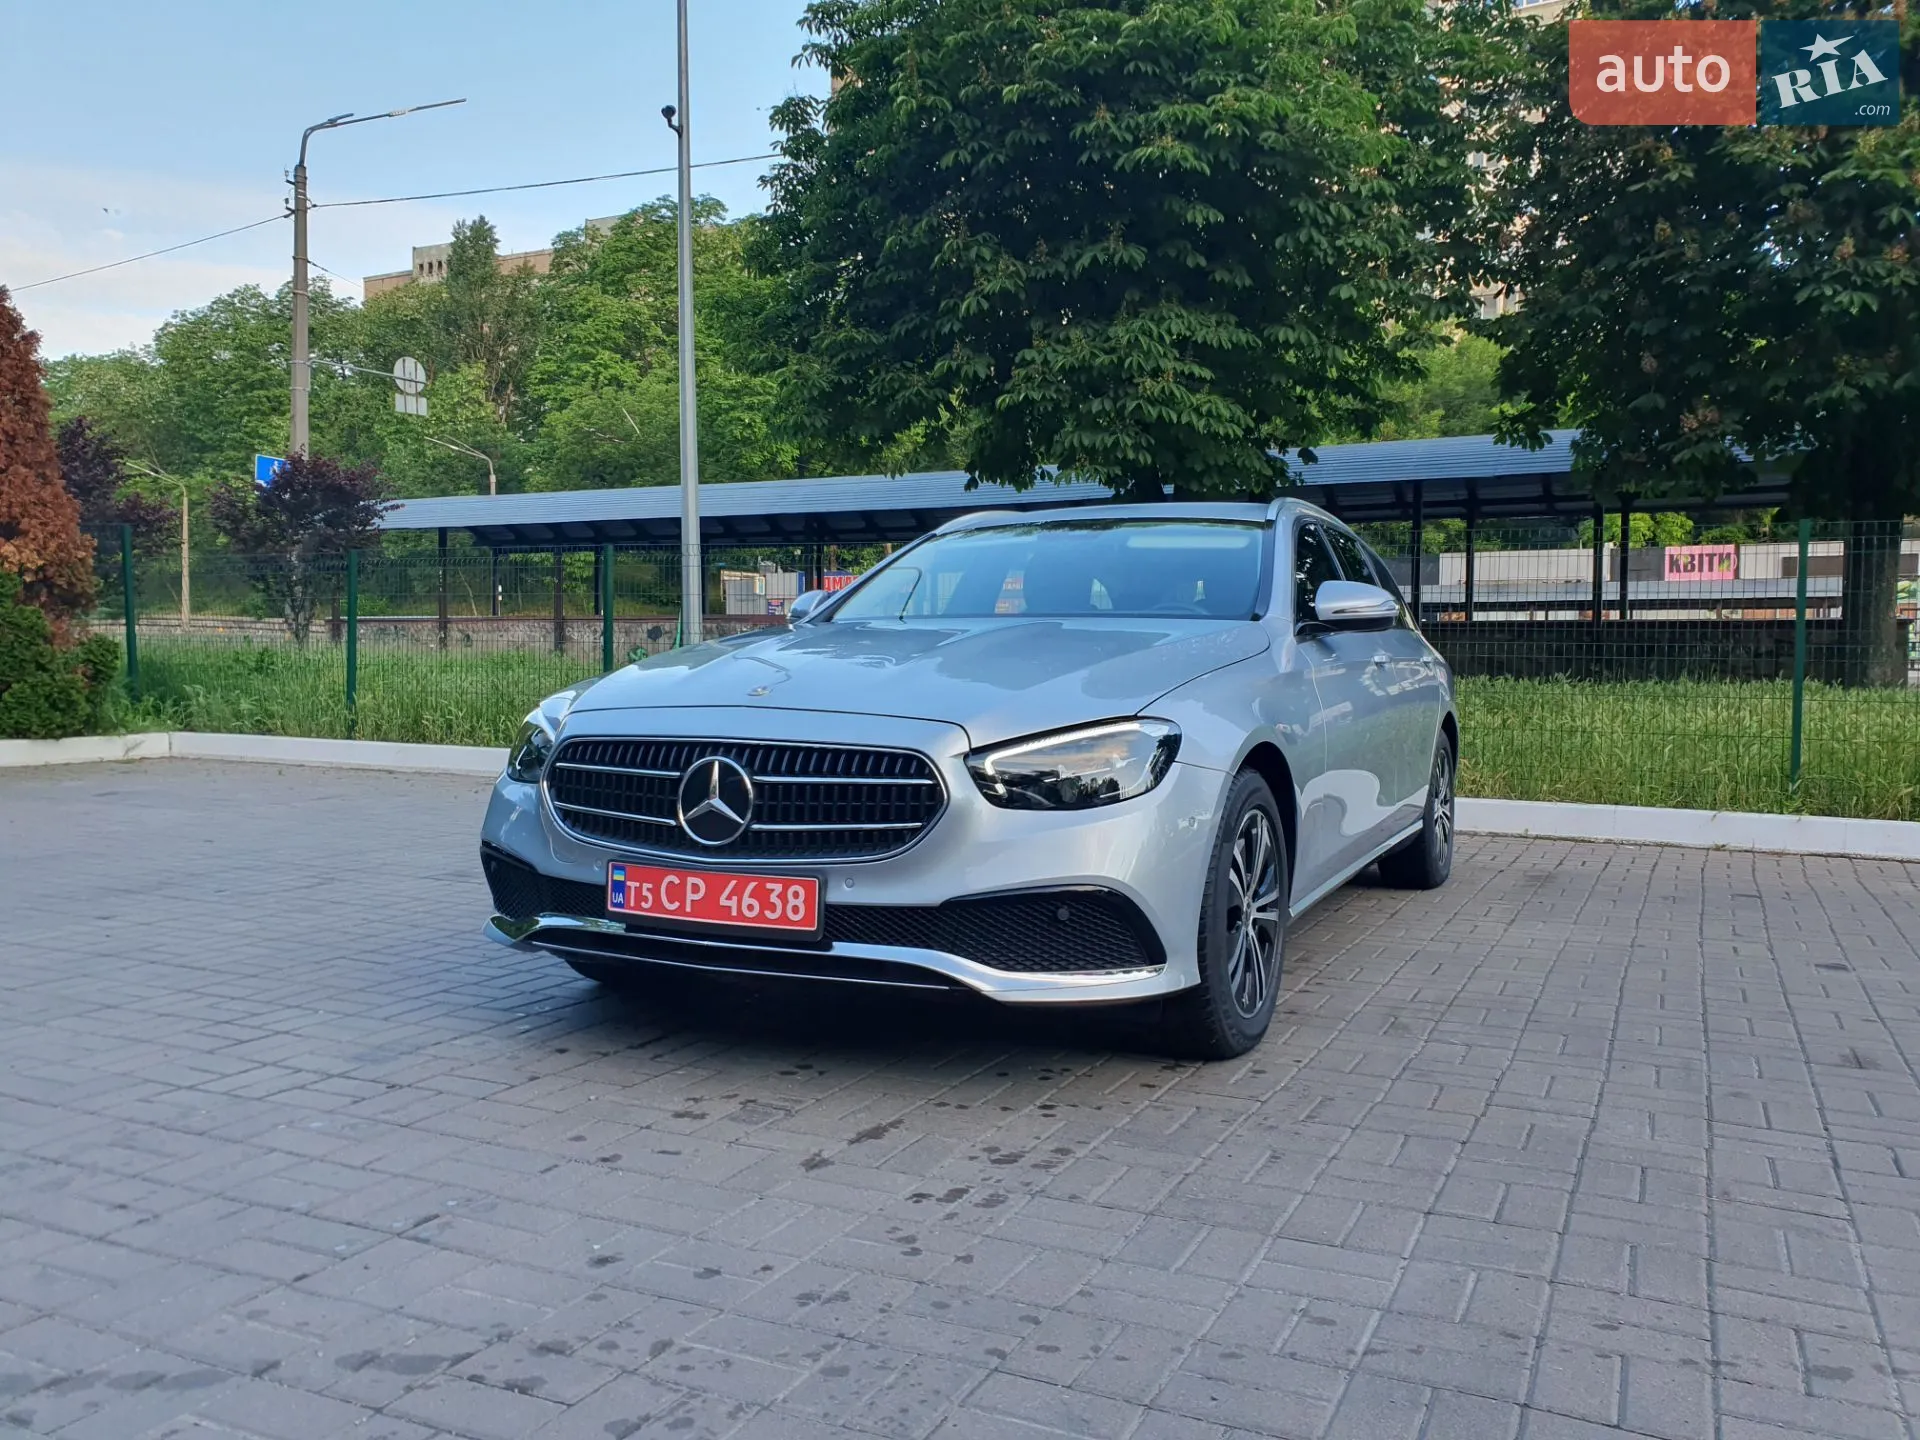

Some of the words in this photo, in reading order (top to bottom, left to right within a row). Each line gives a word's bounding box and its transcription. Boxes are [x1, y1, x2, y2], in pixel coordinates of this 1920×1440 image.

[1668, 552, 1732, 573] КВІТИ
[612, 891, 624, 904] UA
[719, 879, 806, 921] 4638
